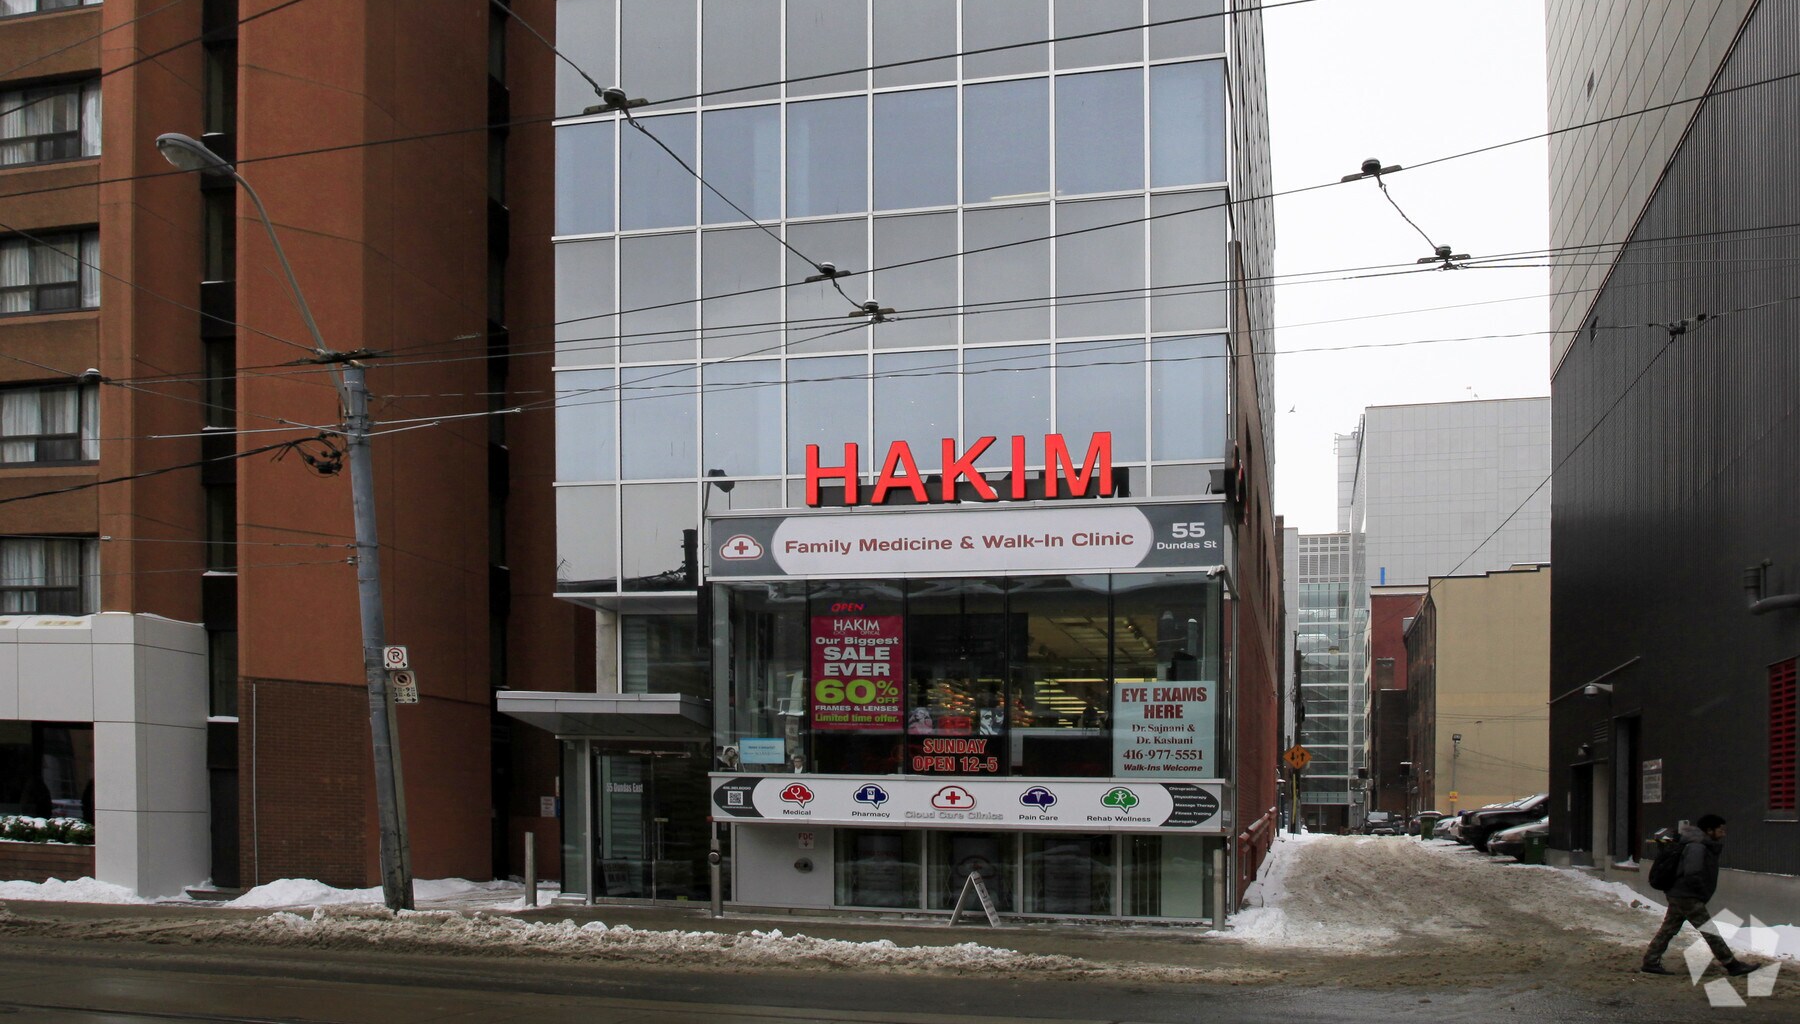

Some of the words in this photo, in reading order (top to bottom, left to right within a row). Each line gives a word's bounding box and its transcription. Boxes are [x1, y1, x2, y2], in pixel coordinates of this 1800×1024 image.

[805, 431, 1114, 507] HAKIM
[1171, 521, 1206, 539] 55
[784, 539, 852, 555] Family
[858, 533, 953, 552] Medicine
[959, 535, 975, 550] &
[981, 531, 1064, 549] Walk-In
[1070, 530, 1134, 547] Clinic
[1156, 540, 1202, 551] Dundas
[1204, 539, 1217, 549] St
[831, 603, 865, 612] OPEN
[833, 619, 880, 631] HAKIM
[815, 637, 840, 645] Our
[844, 636, 899, 646] Biggest
[823, 646, 891, 660] SALE
[824, 662, 890, 676] EVER
[815, 679, 899, 704] 60%
[1121, 687, 1148, 703] EYE
[1152, 686, 1207, 702] EXAMS
[1143, 704, 1184, 719] HERE
[815, 713, 849, 722] Limited
[851, 713, 872, 723] time
[874, 714, 899, 723] offer.
[1132, 724, 1146, 732] Dr.
[1148, 723, 1185, 734] Sajnani
[1186, 724, 1196, 732] &
[923, 738, 987, 754] SUNDAY
[1136, 736, 1151, 745] Dr.
[1153, 736, 1193, 745] Kashani
[1123, 749, 1203, 760] 416-977-5551
[913, 756, 956, 772] OPEN
[960, 756, 998, 772] 12-5
[1123, 764, 1161, 772] Walk-Ins
[1162, 764, 1203, 772] Welcome
[613, 783, 632, 792] Dundas
[632, 783, 643, 792] East
[782, 808, 812, 816] Medical
[851, 810, 891, 818] Pharmacy
[904, 810, 935, 819] Cloud
[938, 811, 964, 820] Care
[966, 811, 1004, 821] Clinics
[1114, 815, 1152, 823] Wellness
